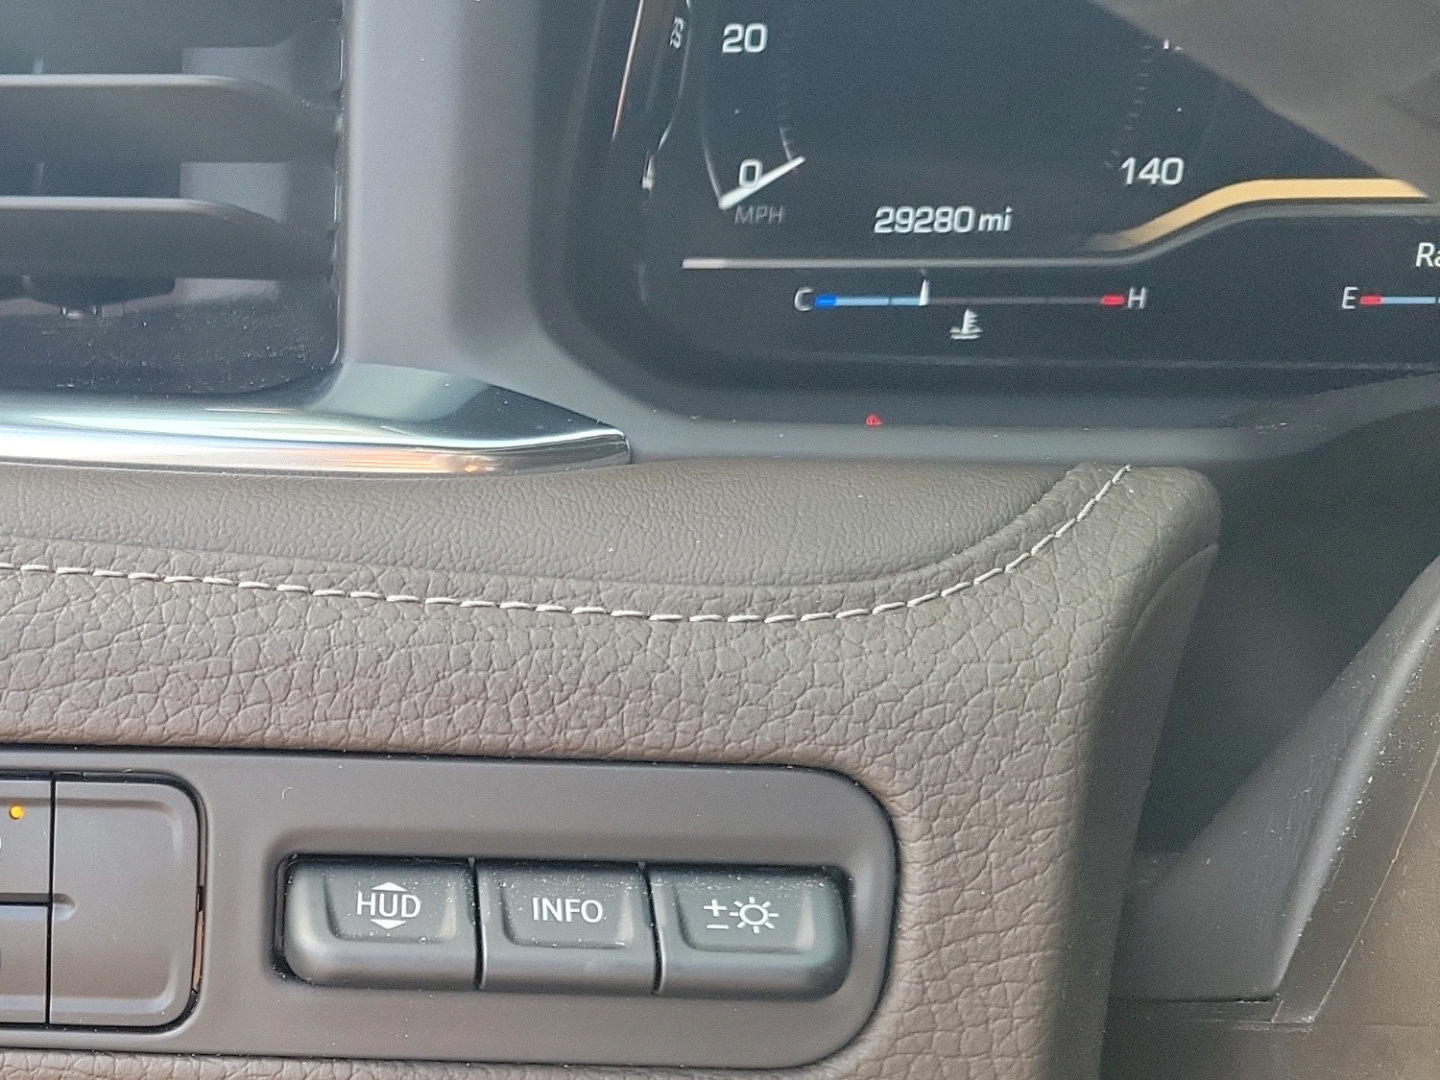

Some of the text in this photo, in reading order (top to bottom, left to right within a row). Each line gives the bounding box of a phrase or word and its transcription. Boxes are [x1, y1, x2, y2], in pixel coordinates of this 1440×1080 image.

[721, 22, 768, 53] 20
[738, 158, 763, 188] 0
[1121, 156, 1184, 186] 140
[734, 205, 784, 225] MPH
[873, 205, 1013, 234] 29280 mi
[794, 286, 814, 312] C
[1127, 286, 1148, 310] H
[1341, 286, 1359, 310] E
[356, 890, 421, 919] HUD
[531, 896, 603, 924] INFO
